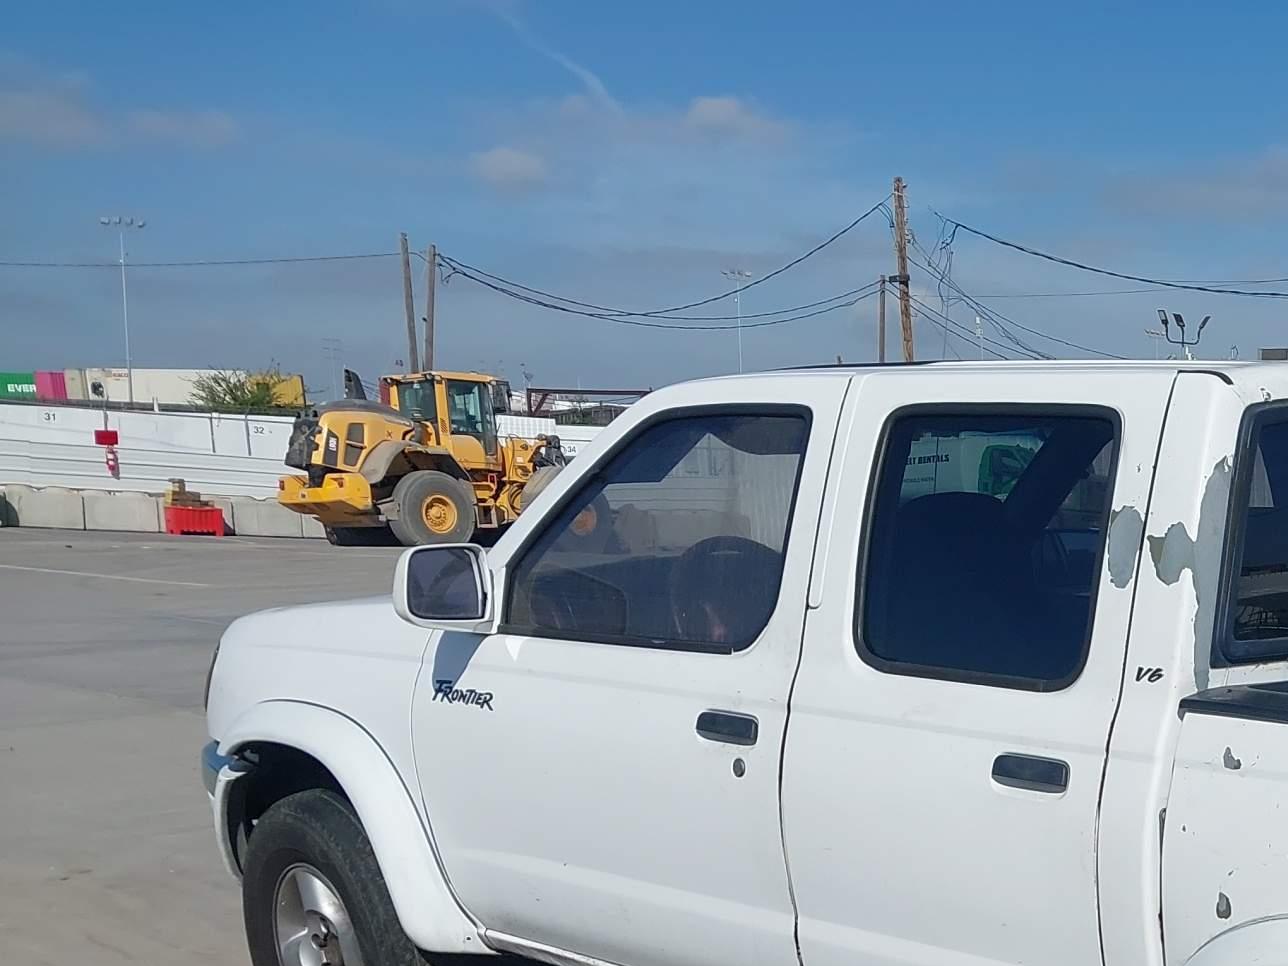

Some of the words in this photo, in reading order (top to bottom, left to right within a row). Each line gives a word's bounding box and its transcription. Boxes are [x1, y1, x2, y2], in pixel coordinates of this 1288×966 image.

[44, 412, 56, 421] 31
[253, 426, 264, 434] 32
[1135, 666, 1165, 683] V6
